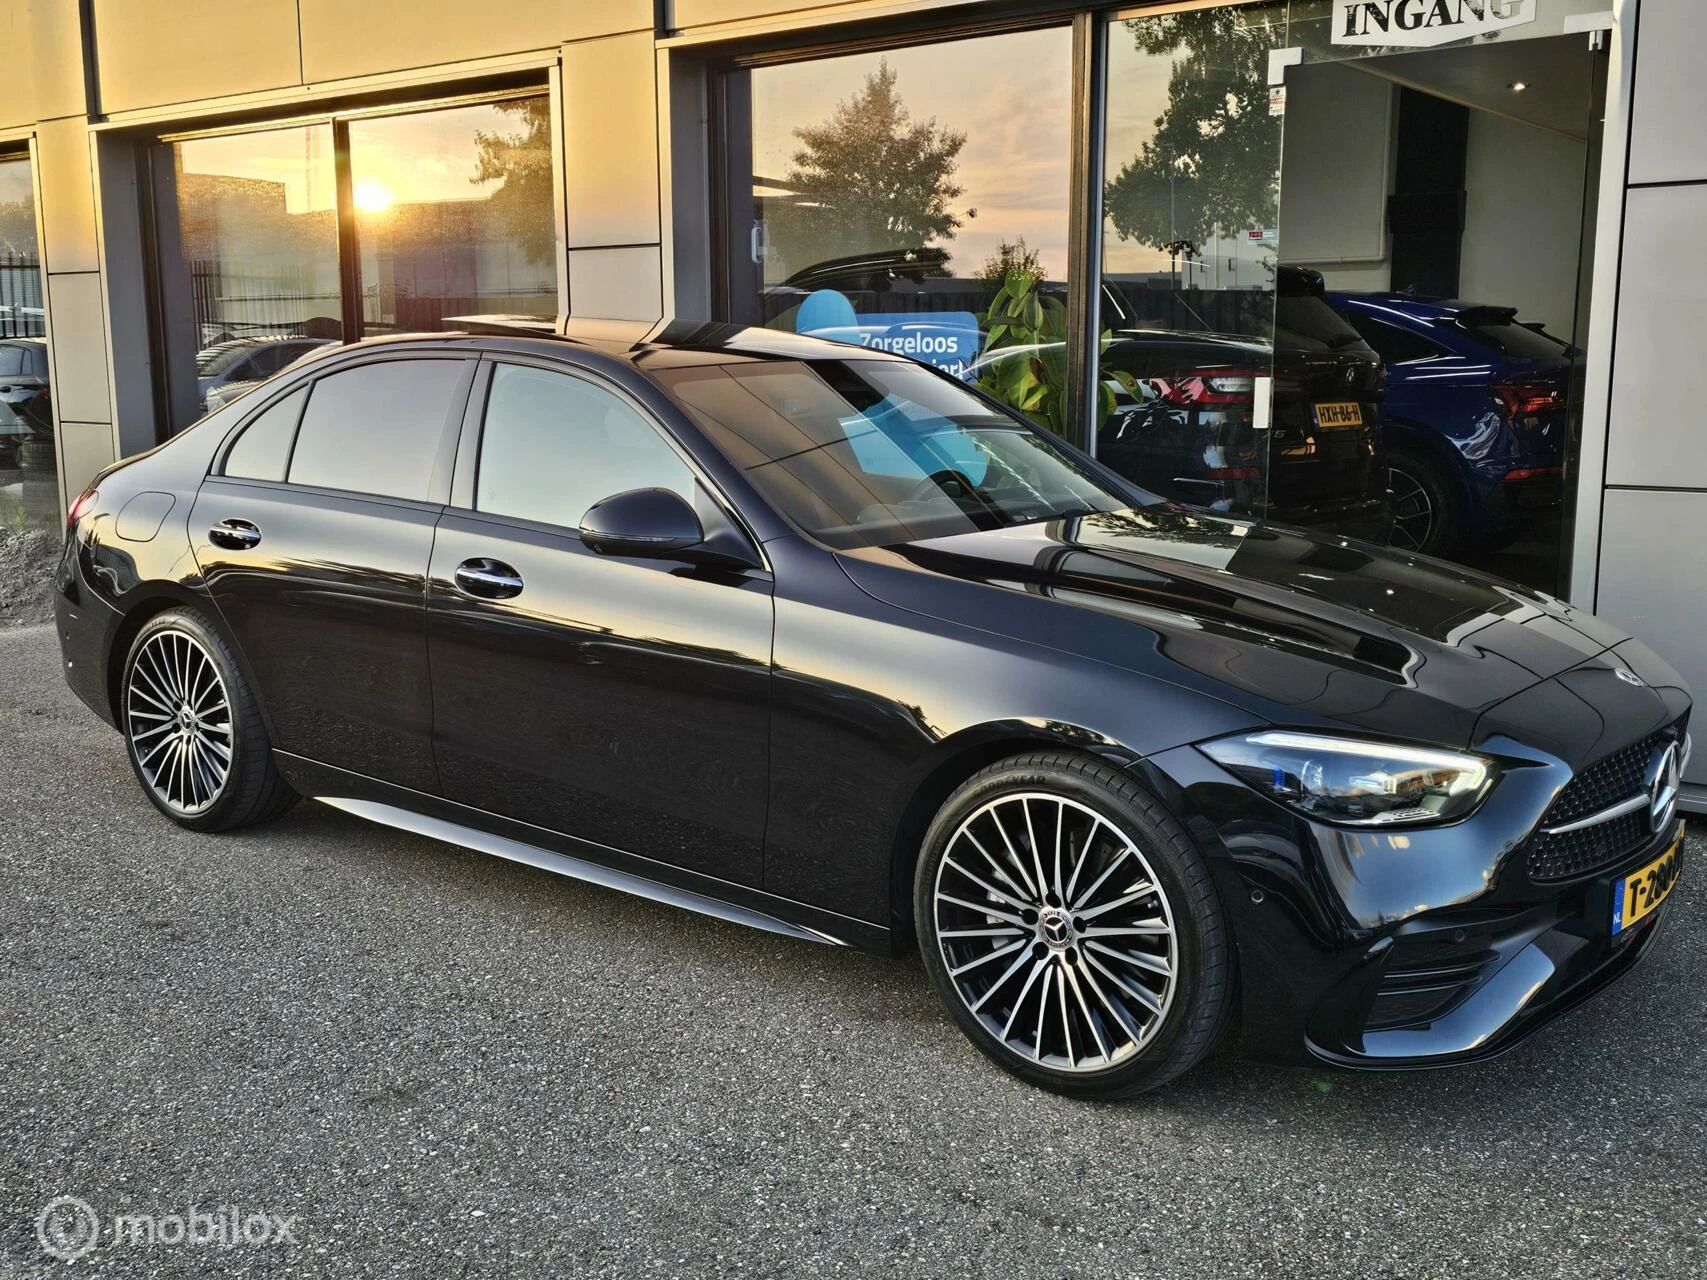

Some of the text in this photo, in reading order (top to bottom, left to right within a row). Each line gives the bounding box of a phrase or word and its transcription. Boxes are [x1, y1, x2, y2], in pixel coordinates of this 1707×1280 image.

[1343, 0, 1522, 37] INGANG
[861, 332, 958, 355] Zorgeloos
[1318, 405, 1360, 424] HXH-86-H
